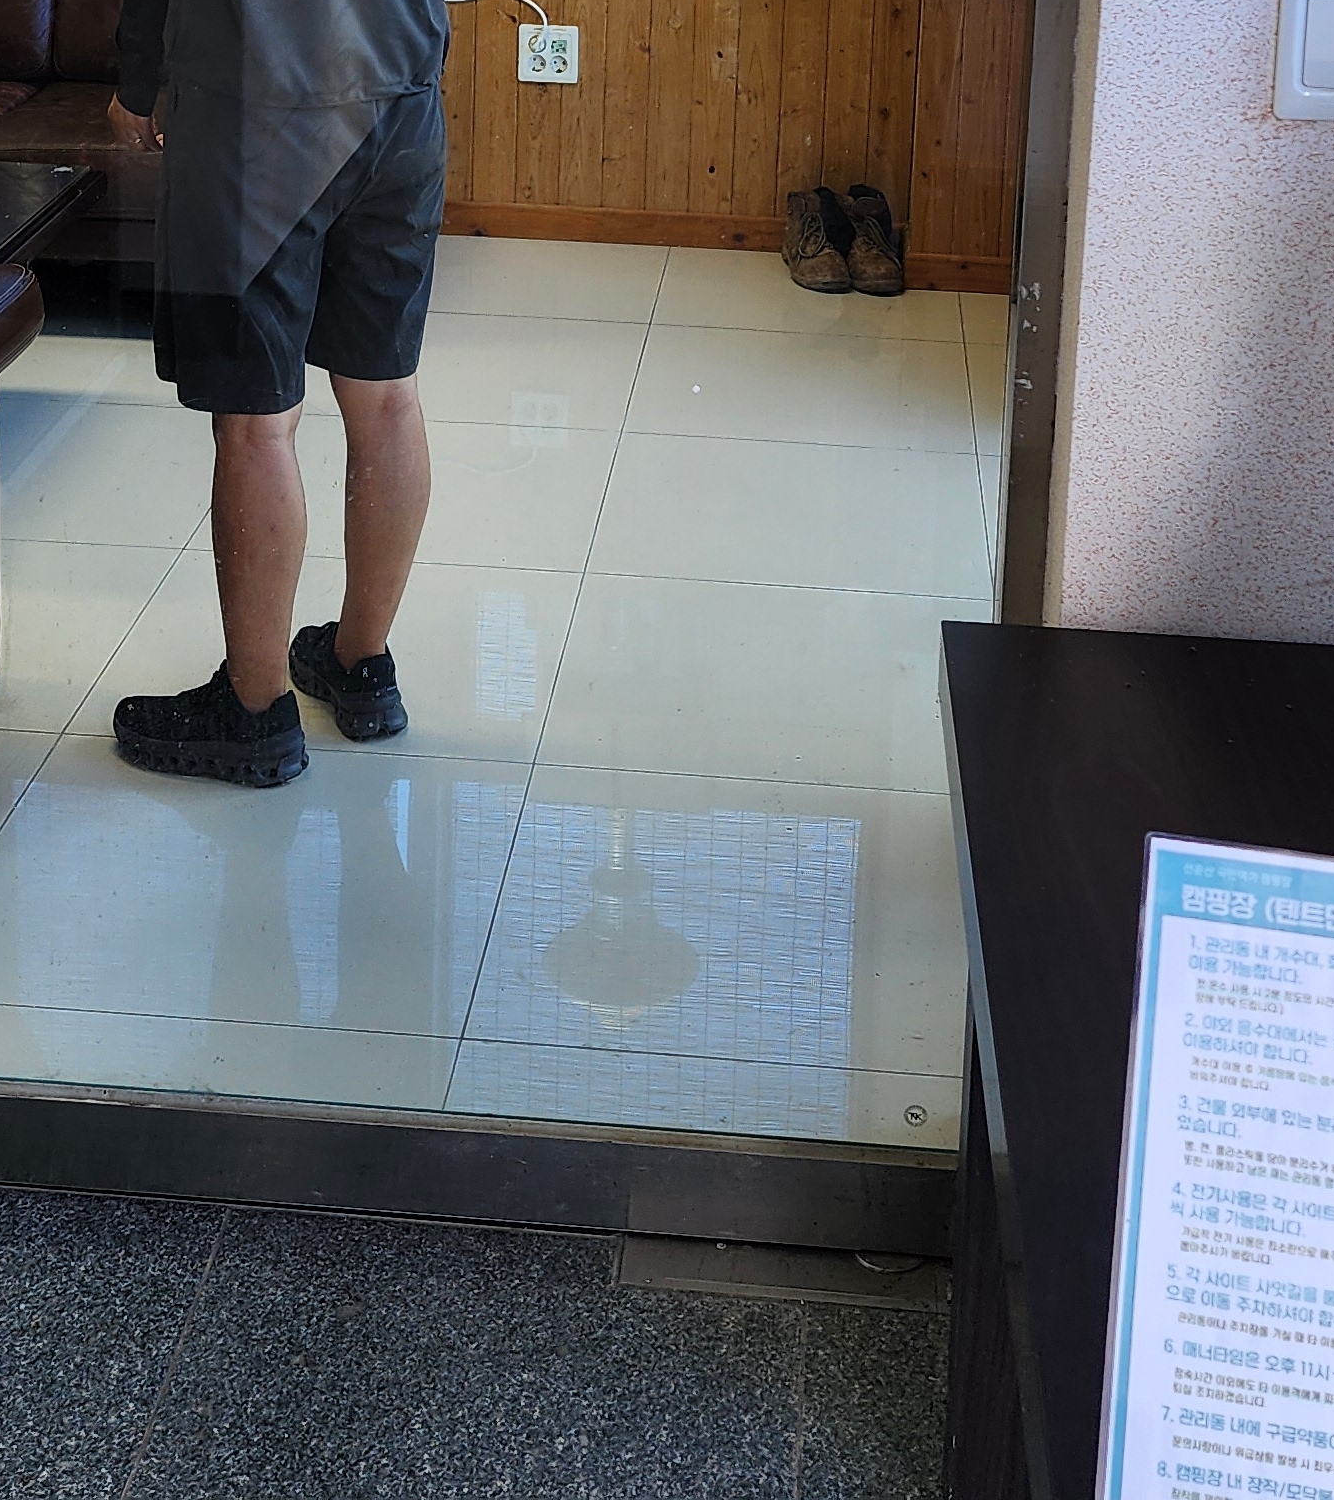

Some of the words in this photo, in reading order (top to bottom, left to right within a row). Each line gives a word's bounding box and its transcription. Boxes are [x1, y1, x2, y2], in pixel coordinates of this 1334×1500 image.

[1183, 884, 1257, 919] 캠핑장
[1190, 935, 1201, 951] 1.
[1206, 936, 1250, 958] 관리동
[1255, 944, 1268, 959] 내
[1273, 946, 1323, 968] 개수대,
[1189, 955, 1219, 973] 이용
[1223, 959, 1303, 984] 가능합니다.
[1185, 1013, 1197, 1028] 2.
[1183, 1032, 1258, 1057] 이용하셔야
[1263, 1044, 1313, 1065] 합니다.
[1178, 1095, 1192, 1110] 3.
[1232, 1103, 1277, 1124] 외부에
[1282, 1110, 1312, 1129] 있는
[1178, 1115, 1242, 1138] 있습니다.
[1172, 1182, 1185, 1196] 4.
[1191, 1183, 1267, 1211] 전기사용은
[1273, 1196, 1287, 1213] 각
[1190, 1205, 1219, 1223] 사용
[1226, 1210, 1305, 1237] 가능합니다.
[1167, 1264, 1180, 1280] 5.
[1186, 1267, 1200, 1283] 각
[1206, 1270, 1252, 1292] 사이트
[1166, 1285, 1196, 1305] 으로
[1201, 1290, 1231, 1310] 이동
[1236, 1296, 1315, 1324] 주차하셔야
[1164, 1339, 1177, 1354] 6.
[1183, 1341, 1260, 1370] 매너타임은
[1265, 1355, 1295, 1374] 오후
[1162, 1405, 1173, 1423] 7.
[1179, 1407, 1225, 1431] 관리동
[1230, 1416, 1261, 1437] 내에
[1157, 1461, 1171, 1478] 8.
[1176, 1463, 1223, 1487] 캠핑장
[1227, 1474, 1242, 1490] 내
